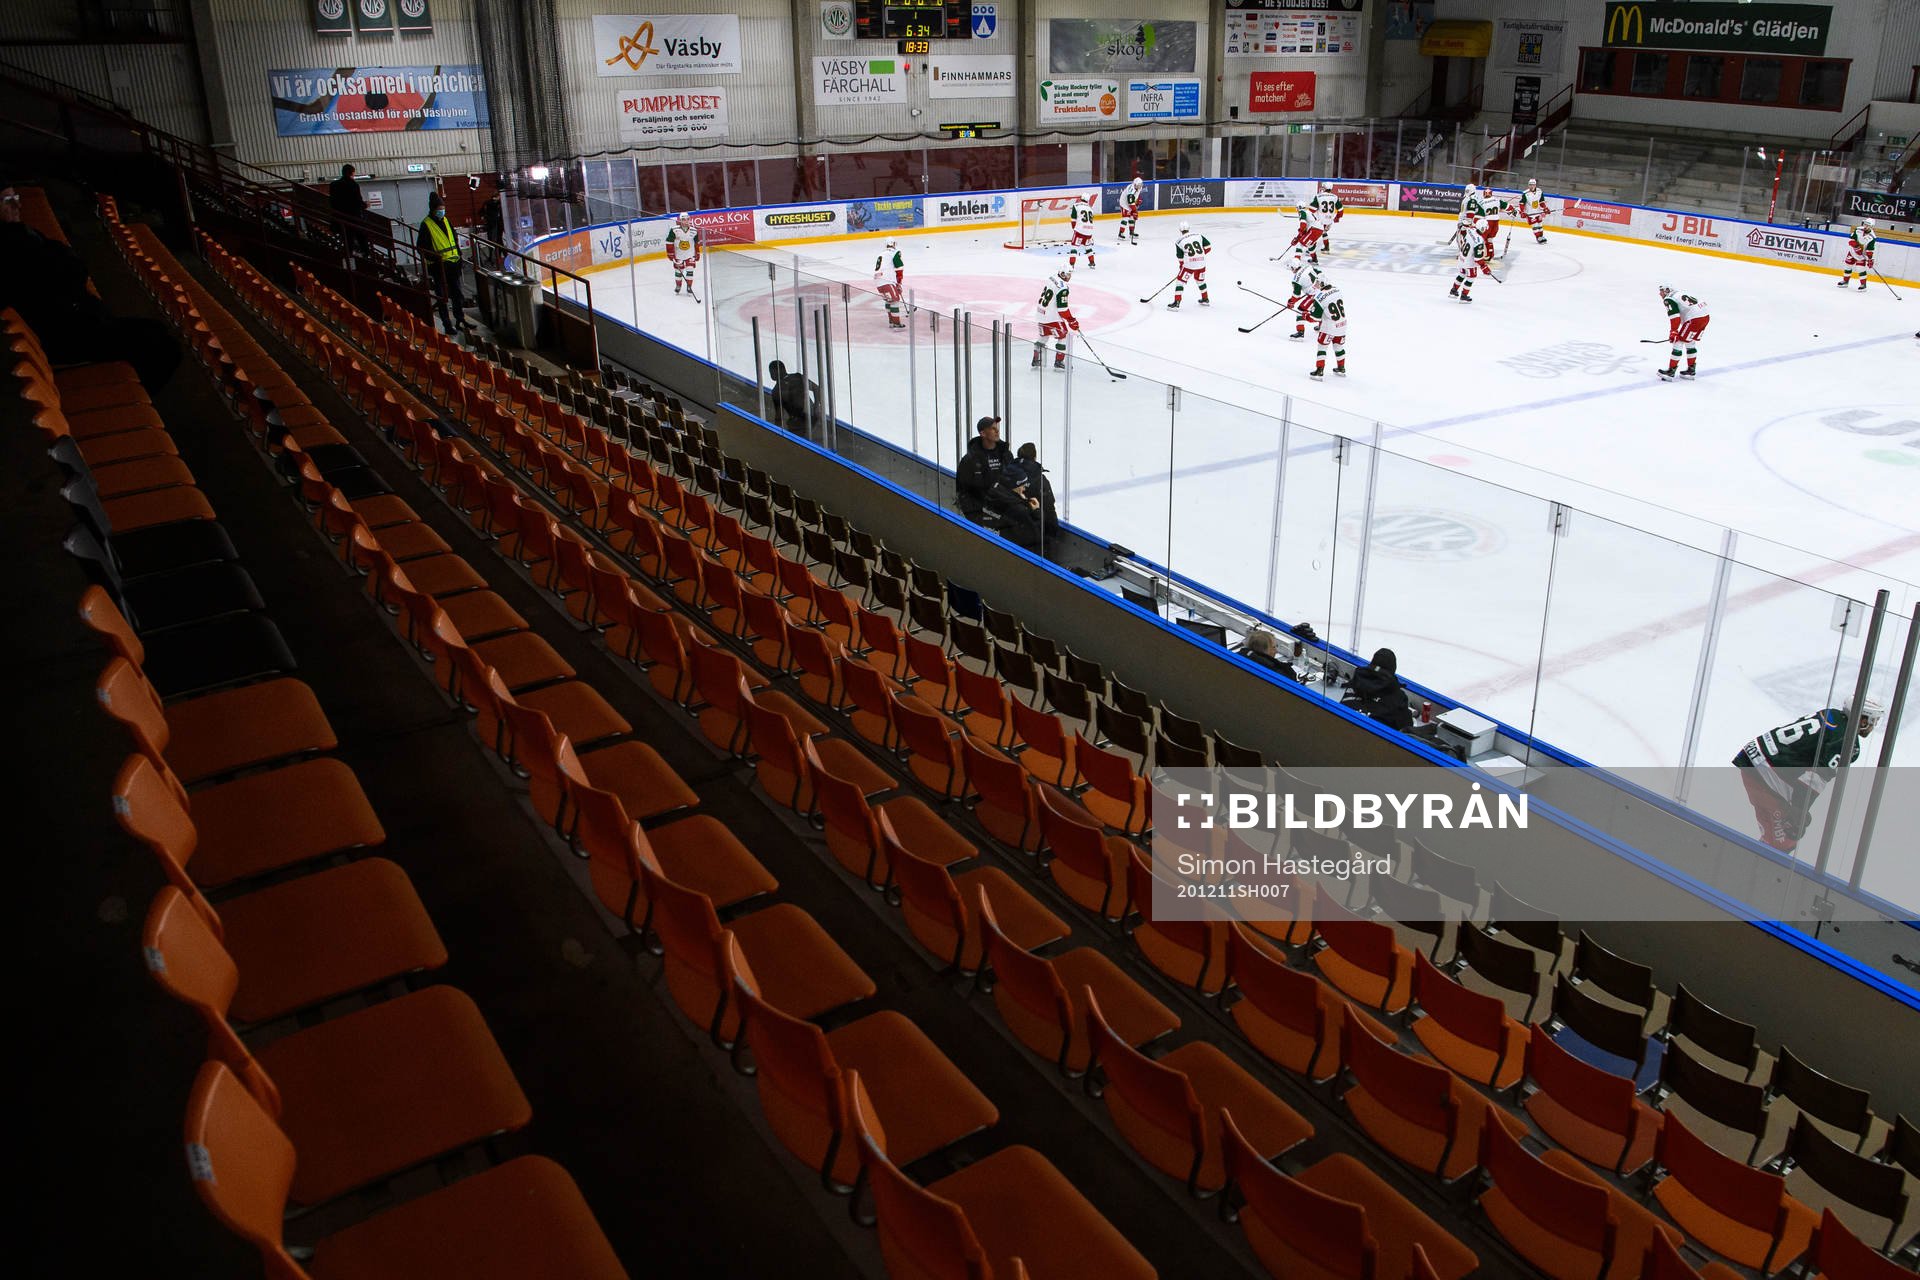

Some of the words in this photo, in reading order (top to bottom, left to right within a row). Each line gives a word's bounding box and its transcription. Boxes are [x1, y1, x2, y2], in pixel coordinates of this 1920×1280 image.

[1649, 17, 1744, 36] McDonald's
[1752, 20, 1819, 42] Glädjen
[663, 36, 722, 59] Väsby
[905, 41, 929, 53] 18:33
[1107, 38, 1145, 61] skog
[822, 59, 867, 76] VÄSBY
[941, 71, 1012, 81] FINNHAMMARS
[272, 76, 292, 98] Vi
[295, 74, 313, 98] är
[317, 71, 367, 97] också
[369, 72, 406, 96] med
[409, 72, 415, 94] i
[823, 77, 896, 94] FÄRGHALL
[1255, 81, 1263, 91] Vi
[1275, 81, 1294, 91] efter
[623, 94, 722, 114] PUMPHUSET
[1140, 93, 1164, 102] INFRA
[1255, 92, 1287, 103] matchen!
[1053, 105, 1097, 114] Fruktdealen
[1143, 102, 1160, 112] CITY
[298, 111, 331, 123] Gratis
[386, 108, 401, 119] för
[402, 107, 422, 119] alla
[632, 115, 672, 124] Försäljning
[674, 114, 688, 122] och
[689, 113, 715, 121] service
[1185, 184, 1206, 195] Hyldig
[1418, 188, 1435, 196] Uffe
[1435, 189, 1462, 199] Tryckare
[1185, 196, 1201, 206] Bygg
[1202, 194, 1212, 203] AB
[1321, 200, 1335, 213] 33
[1850, 195, 1906, 217] Ruccola
[940, 199, 989, 217] Pahlén
[727, 211, 751, 223] KÖK
[769, 211, 832, 225] HYRESHUSET
[1662, 213, 1679, 231] J
[1683, 215, 1719, 238] BIL
[600, 231, 623, 258] vlg
[1183, 240, 1203, 257] 39
[1764, 234, 1819, 254] BYGMA
